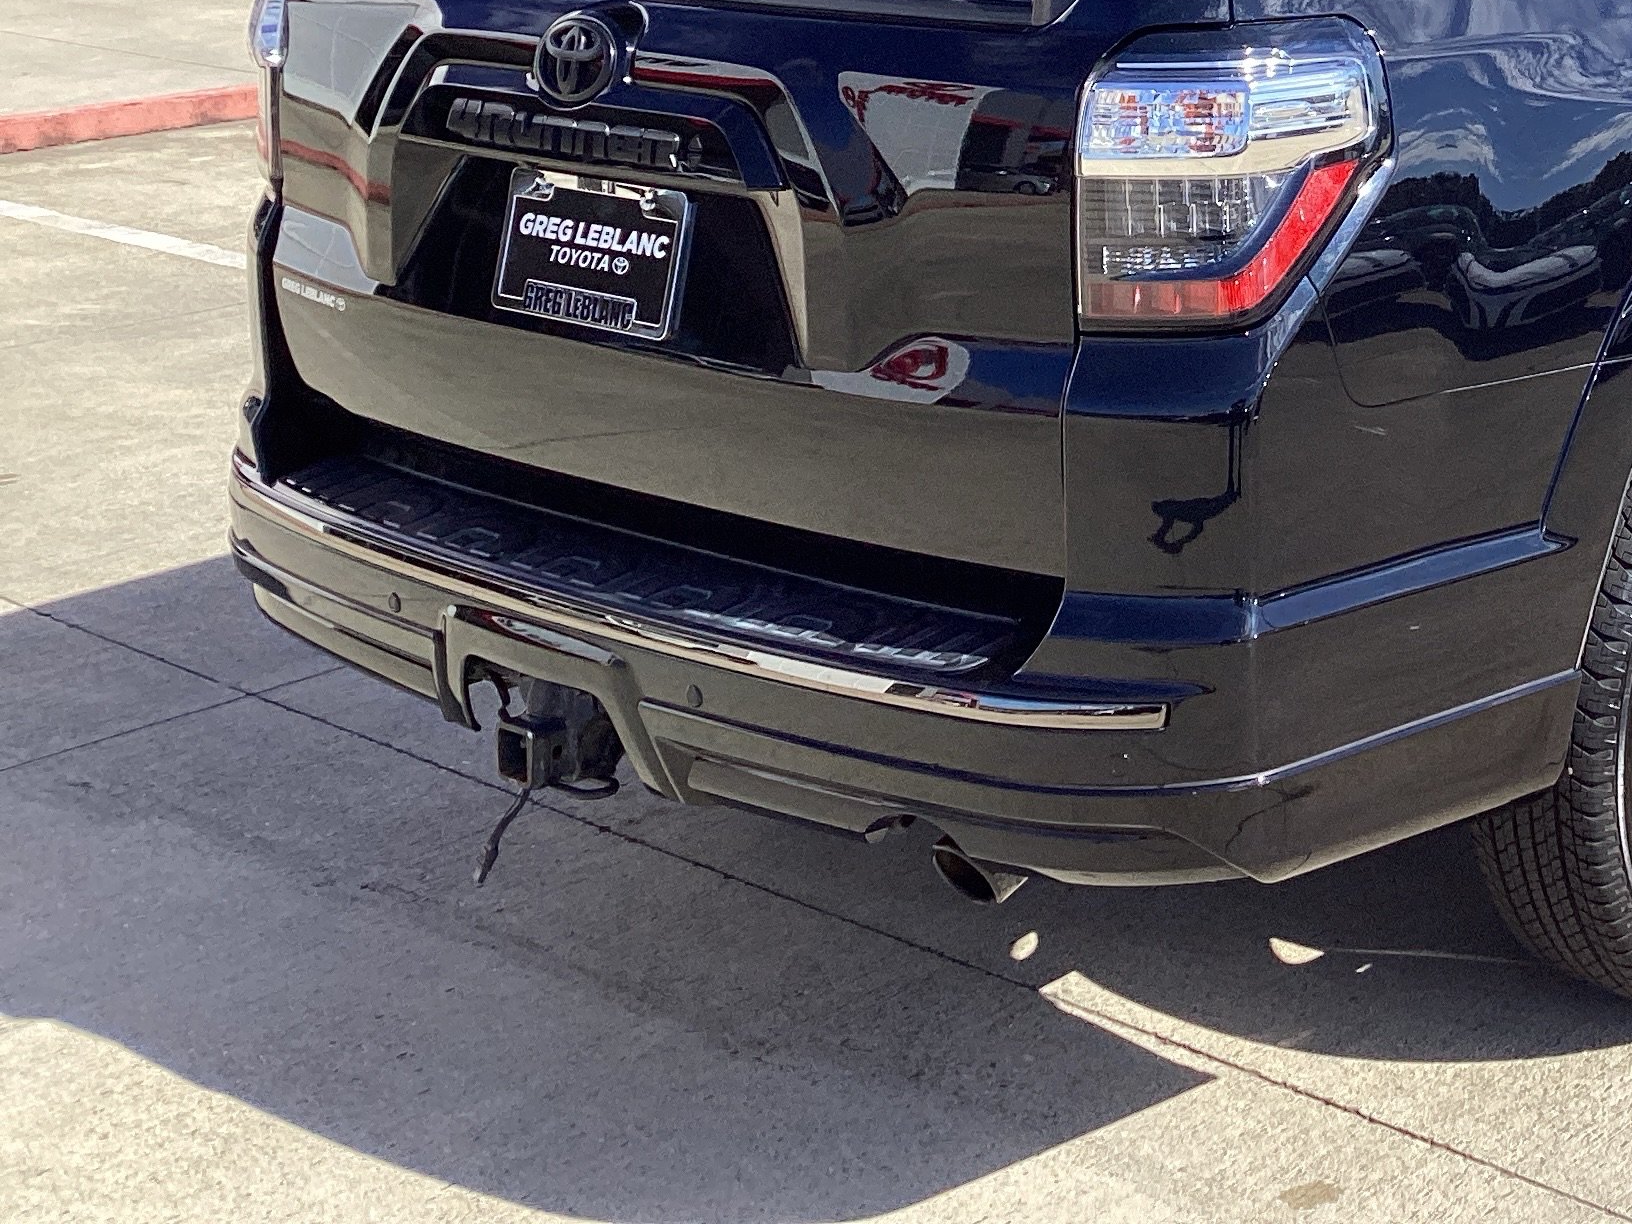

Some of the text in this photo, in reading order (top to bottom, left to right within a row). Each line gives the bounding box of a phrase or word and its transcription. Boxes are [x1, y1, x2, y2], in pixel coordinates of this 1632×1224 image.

[519, 213, 669, 259] GREG LEBLANC
[549, 245, 609, 272] TOYOTA
[523, 282, 564, 315] GREG
